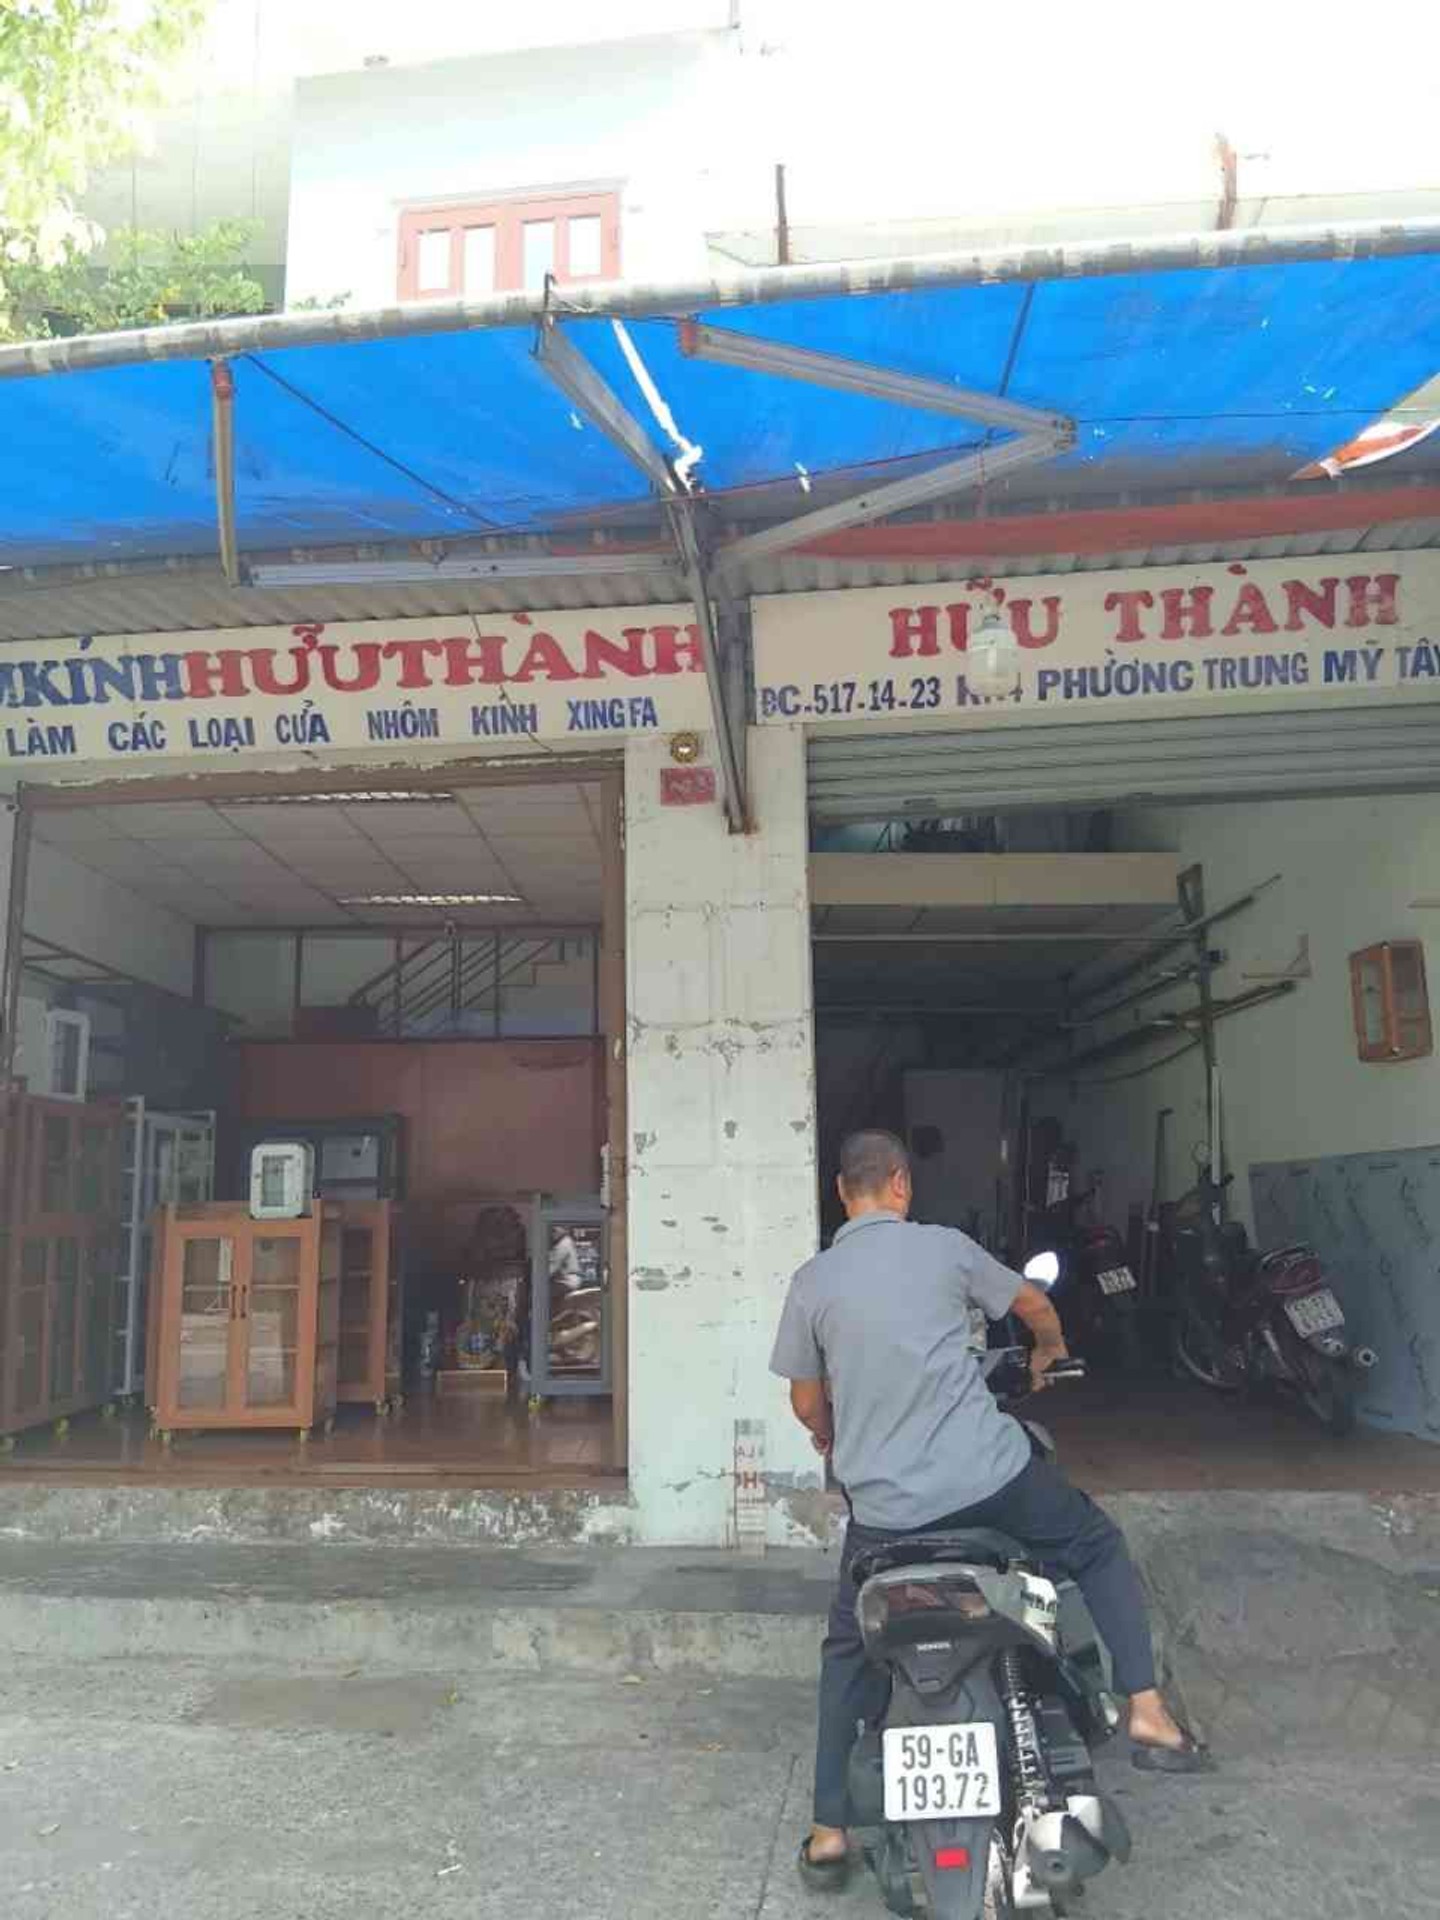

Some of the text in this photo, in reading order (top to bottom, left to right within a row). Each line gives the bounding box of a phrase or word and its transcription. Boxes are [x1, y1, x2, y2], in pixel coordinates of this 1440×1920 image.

[1103, 563, 1400, 642] THÀNH
[1037, 648, 1194, 701] PHƯỜNG
[1203, 651, 1309, 690] TRUNG
[1323, 638, 1385, 683] MỸ
[6, 717, 77, 757] LÀM
[107, 711, 166, 751] CÁC
[189, 717, 256, 752] LOẠI
[275, 699, 331, 744] CỬA
[366, 701, 440, 740] NHÔM
[901, 1732, 981, 1770] 59-GA
[896, 1772, 992, 1812] 193.72
